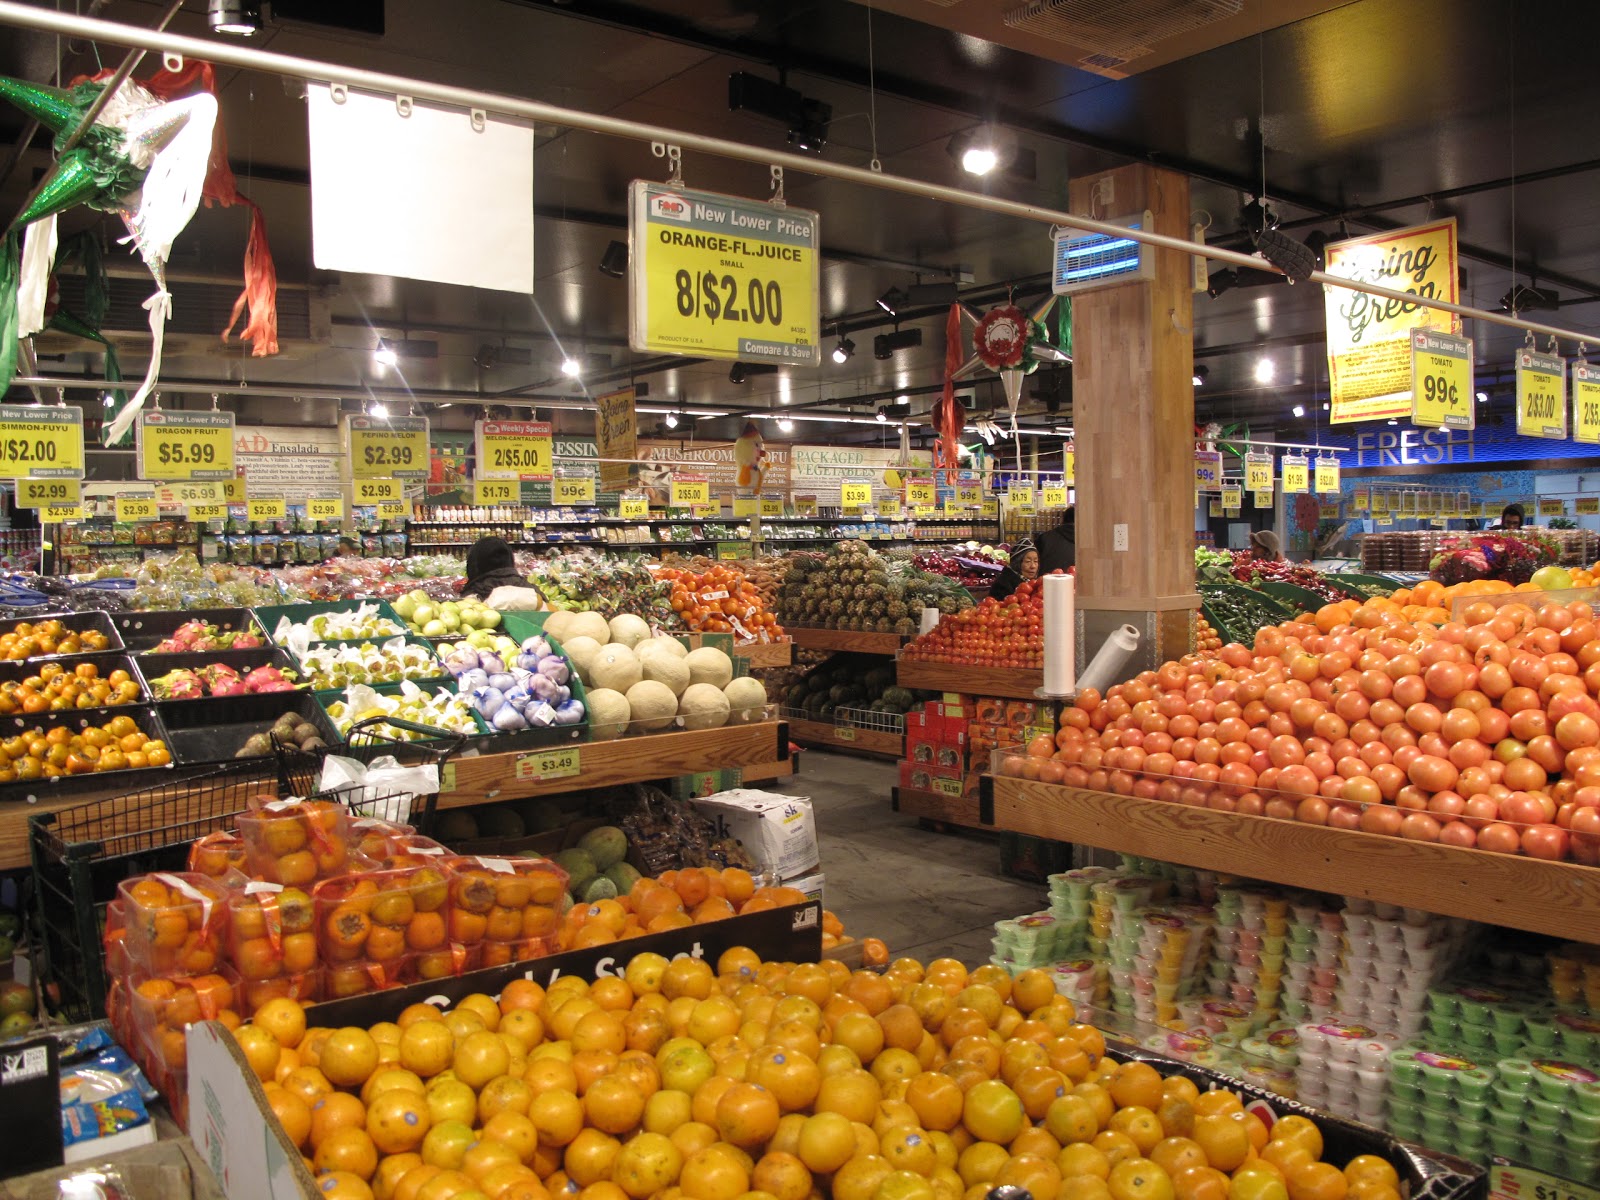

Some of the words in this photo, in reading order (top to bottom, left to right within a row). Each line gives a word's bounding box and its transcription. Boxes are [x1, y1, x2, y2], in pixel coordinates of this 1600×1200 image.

[695, 203, 726, 224] New
[730, 210, 772, 232] Lower
[777, 218, 811, 238] Price
[660, 230, 802, 262] ORANGE-FL.JUICE
[720, 259, 744, 269] SMALL
[676, 268, 783, 326] 8/$2.00
[745, 342, 782, 356] Compare
[784, 345, 790, 356] &
[792, 346, 810, 358] Save
[1428, 338, 1439, 348] New
[1440, 340, 1454, 351] Lower
[1455, 344, 1466, 354] Price
[1430, 357, 1452, 368] TOMATO
[1534, 375, 1551, 383] TOMATO
[1424, 374, 1458, 410] 99¢
[1527, 392, 1555, 419] 2/$3.00
[0, 423, 68, 432] SIMMON-FUYU
[500, 425, 524, 433] Weekly
[526, 425, 550, 433] Special
[0, 438, 56, 463] /$2.00
[272, 444, 319, 453] Ensalada
[1358, 428, 1474, 466] FRESH
[159, 442, 215, 465] $5.99
[364, 445, 412, 467] $2.99
[495, 448, 538, 468] 2/$5.00
[652, 448, 736, 462] MUSHROOM
[796, 450, 864, 464] PACKAGED
[796, 464, 876, 476] VEGETABLES
[1197, 469, 1214, 482] 99¢
[1252, 471, 1268, 483] $1.79
[1288, 474, 1303, 485] $1.99
[29, 485, 67, 498] $2.99
[181, 489, 216, 499] $6.99
[361, 485, 391, 497] $2.99
[483, 486, 509, 498] $1.79
[561, 486, 586, 498] 99¢
[678, 490, 701, 500] 2/$5.00
[847, 492, 865, 500] $3.99
[911, 490, 928, 500] 99¢
[960, 492, 977, 500] 99¢
[48, 508, 74, 516] $2.99
[124, 505, 149, 515] $2.99
[195, 506, 219, 515] $2.99
[254, 506, 277, 514] $2.99
[313, 506, 335, 514] $2.99
[383, 505, 403, 513] $2.99
[625, 505, 642, 513] $1.49
[542, 758, 572, 771] $3.49
[943, 785, 959, 794] $3.99
[785, 804, 798, 818] sk
[1217, 1071, 1316, 1116] WONDERFUL
